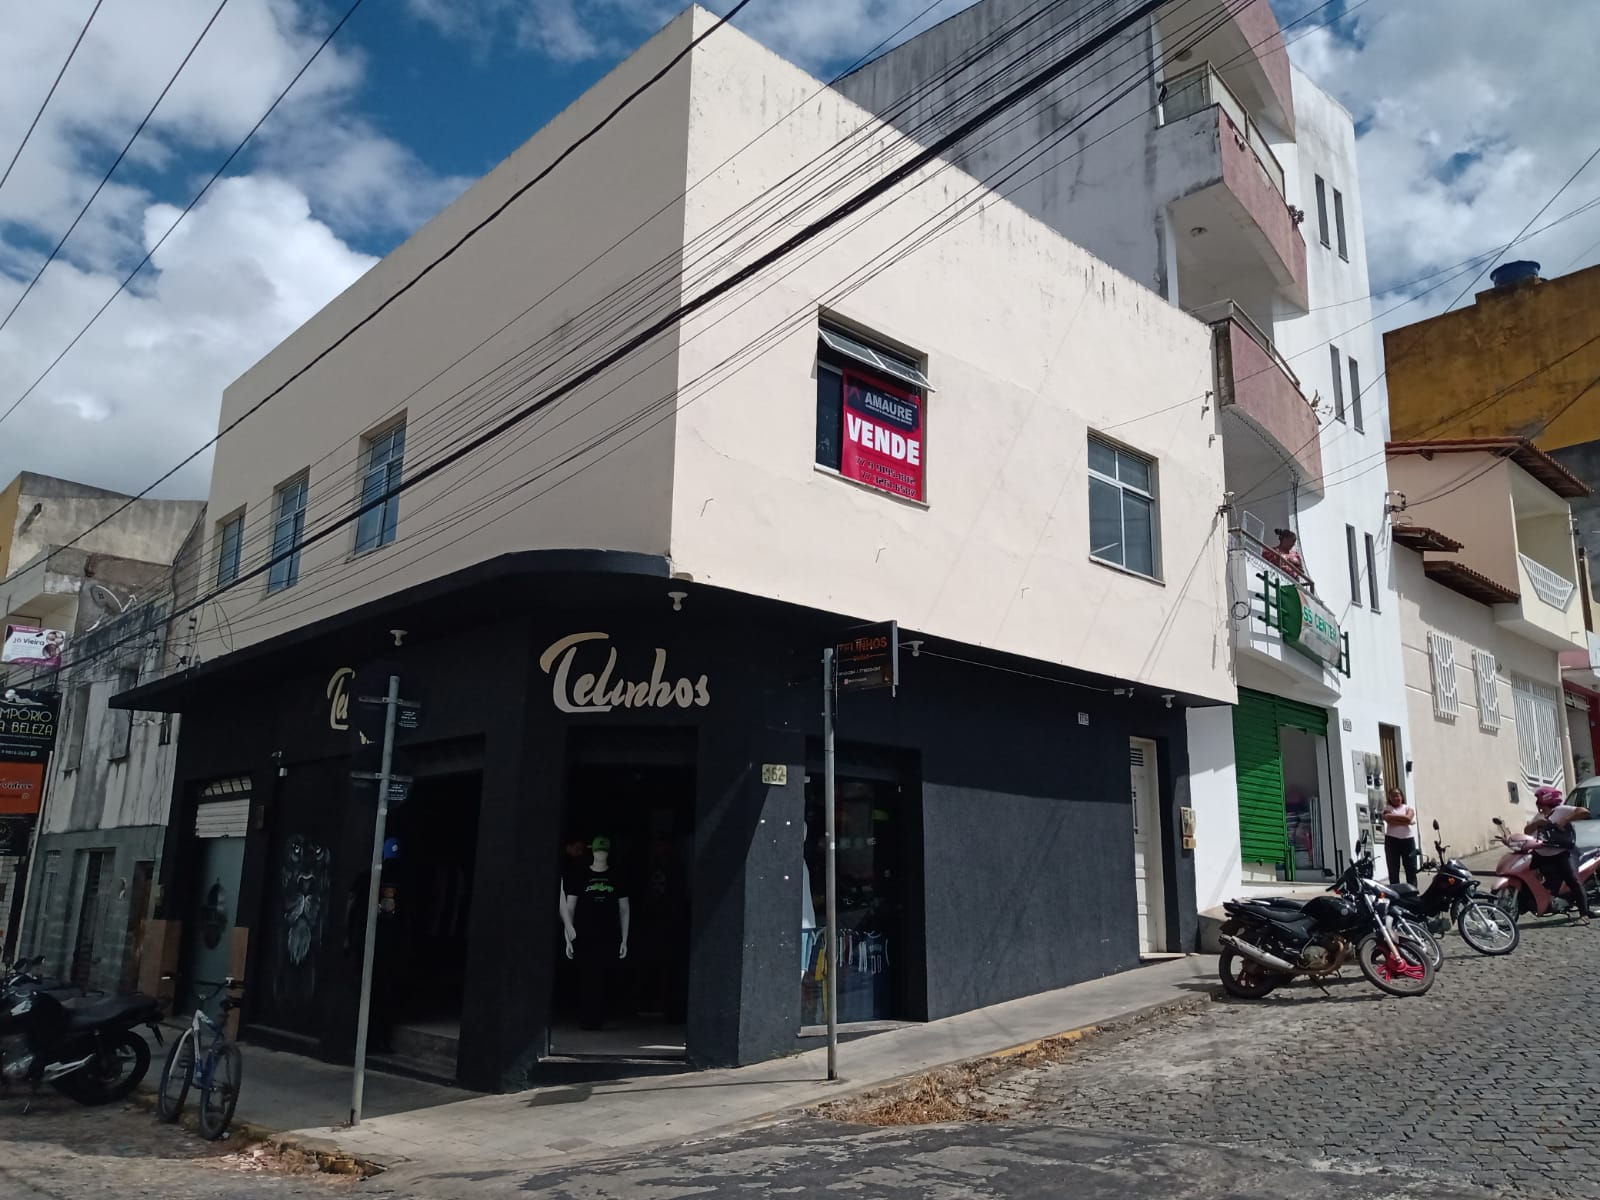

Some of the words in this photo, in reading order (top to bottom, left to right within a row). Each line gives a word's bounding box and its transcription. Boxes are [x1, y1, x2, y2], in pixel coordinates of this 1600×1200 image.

[864, 392, 913, 421] AMAURE
[846, 412, 920, 466] VENDE
[11, 721, 53, 736] BELEZA
